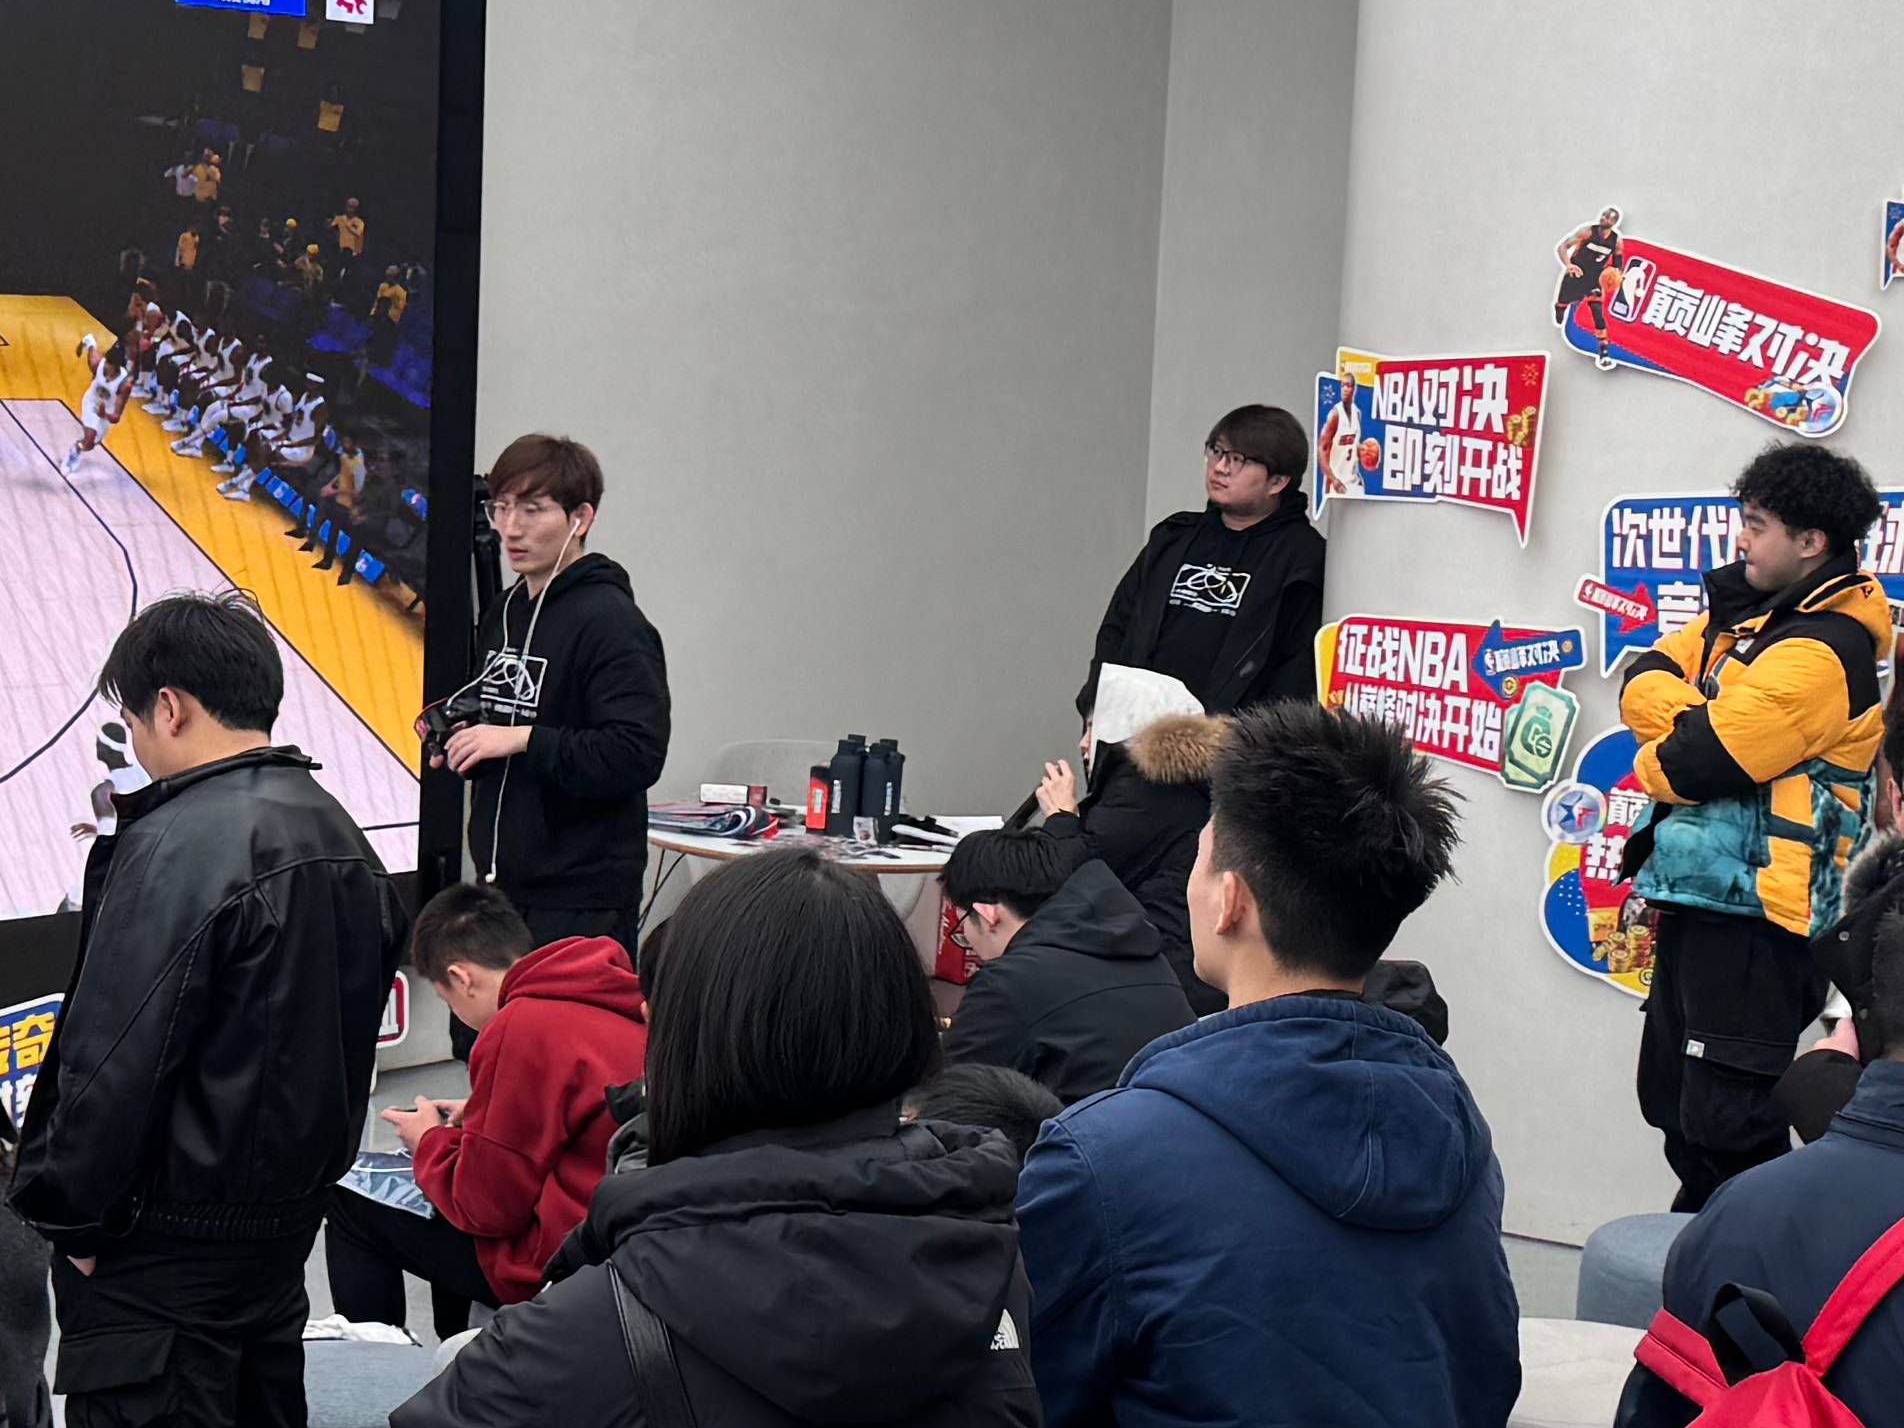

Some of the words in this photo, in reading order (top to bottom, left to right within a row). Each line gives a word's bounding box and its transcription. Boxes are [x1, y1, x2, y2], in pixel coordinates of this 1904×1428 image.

[1641, 275, 1850, 388] 巅峰对决
[1371, 364, 1508, 433] NBA对决
[1382, 424, 1523, 500] 即刻开战
[1338, 624, 1469, 693] 征战NBA
